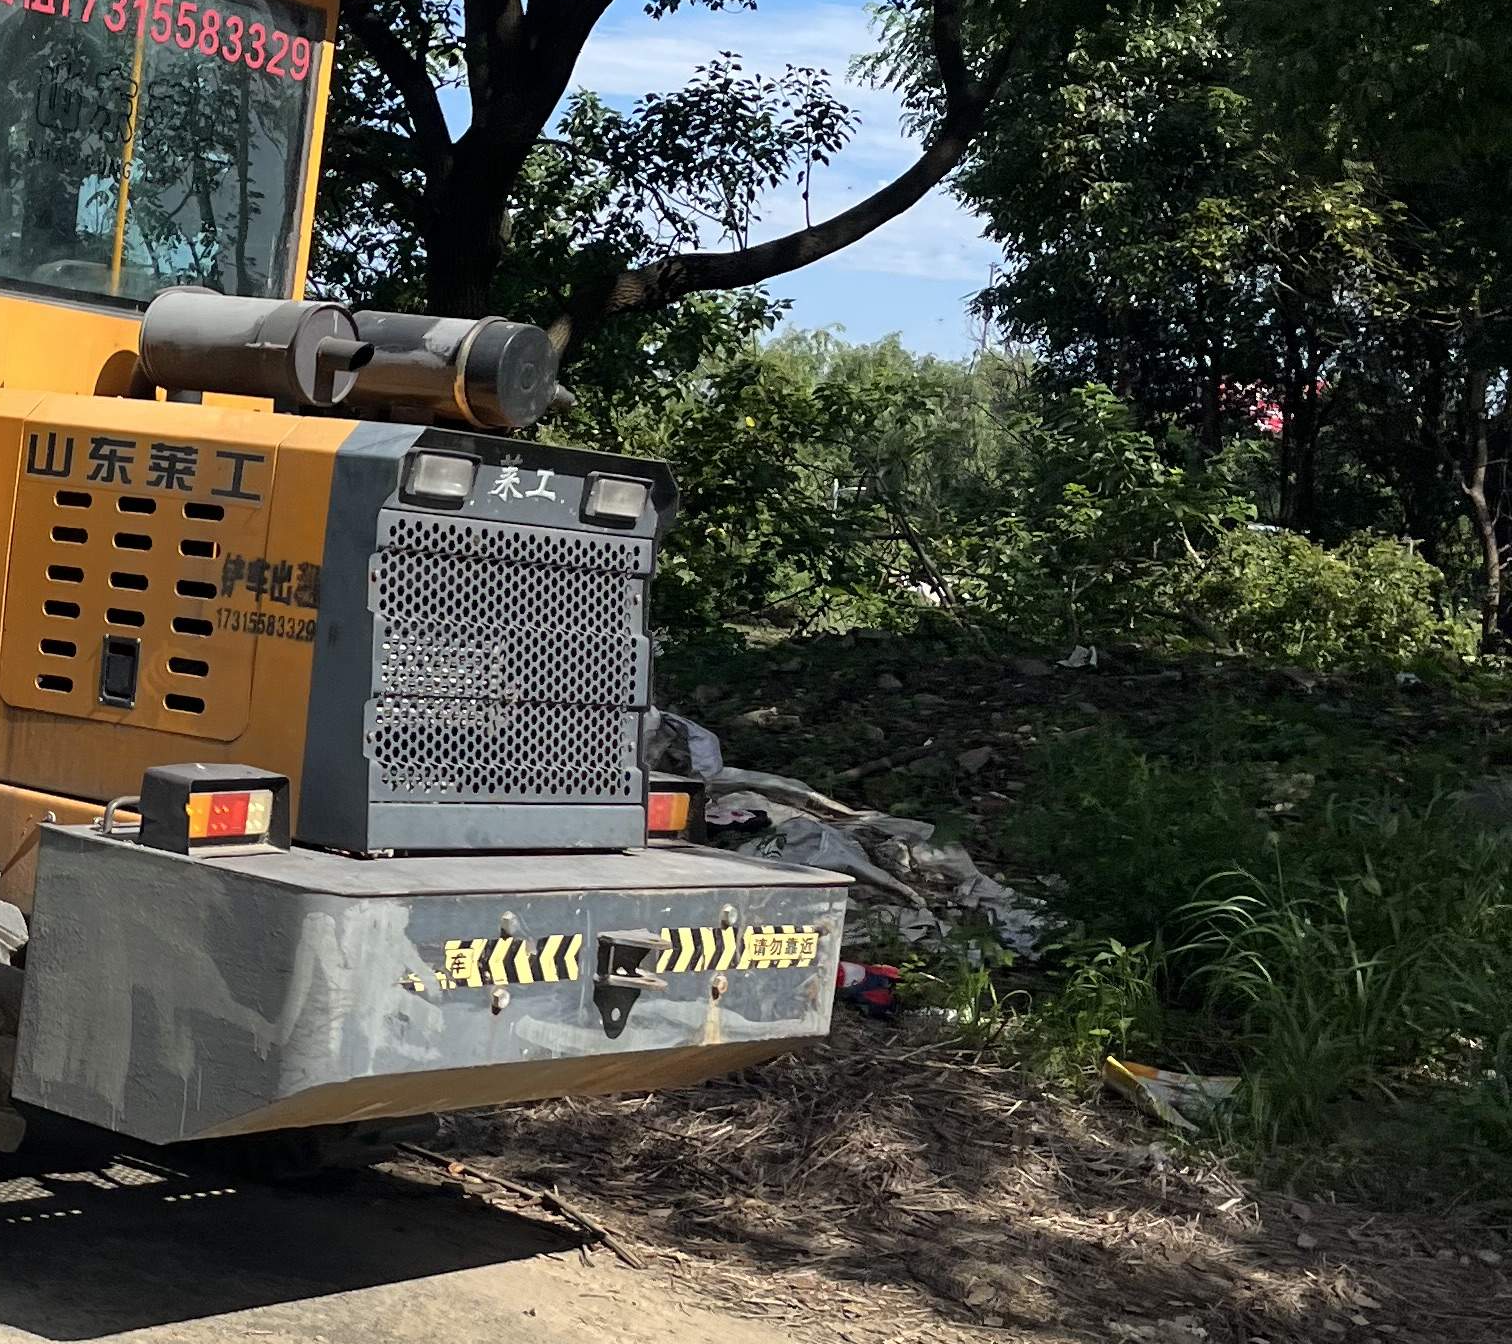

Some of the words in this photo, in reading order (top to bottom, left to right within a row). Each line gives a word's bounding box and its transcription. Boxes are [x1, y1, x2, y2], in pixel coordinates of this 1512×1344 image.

[27, 432, 265, 502] 山东莱工
[488, 454, 556, 502] 莱工
[216, 607, 317, 642] 17315583329
[450, 952, 467, 974] 车
[753, 937, 814, 956] 请勿靠近
